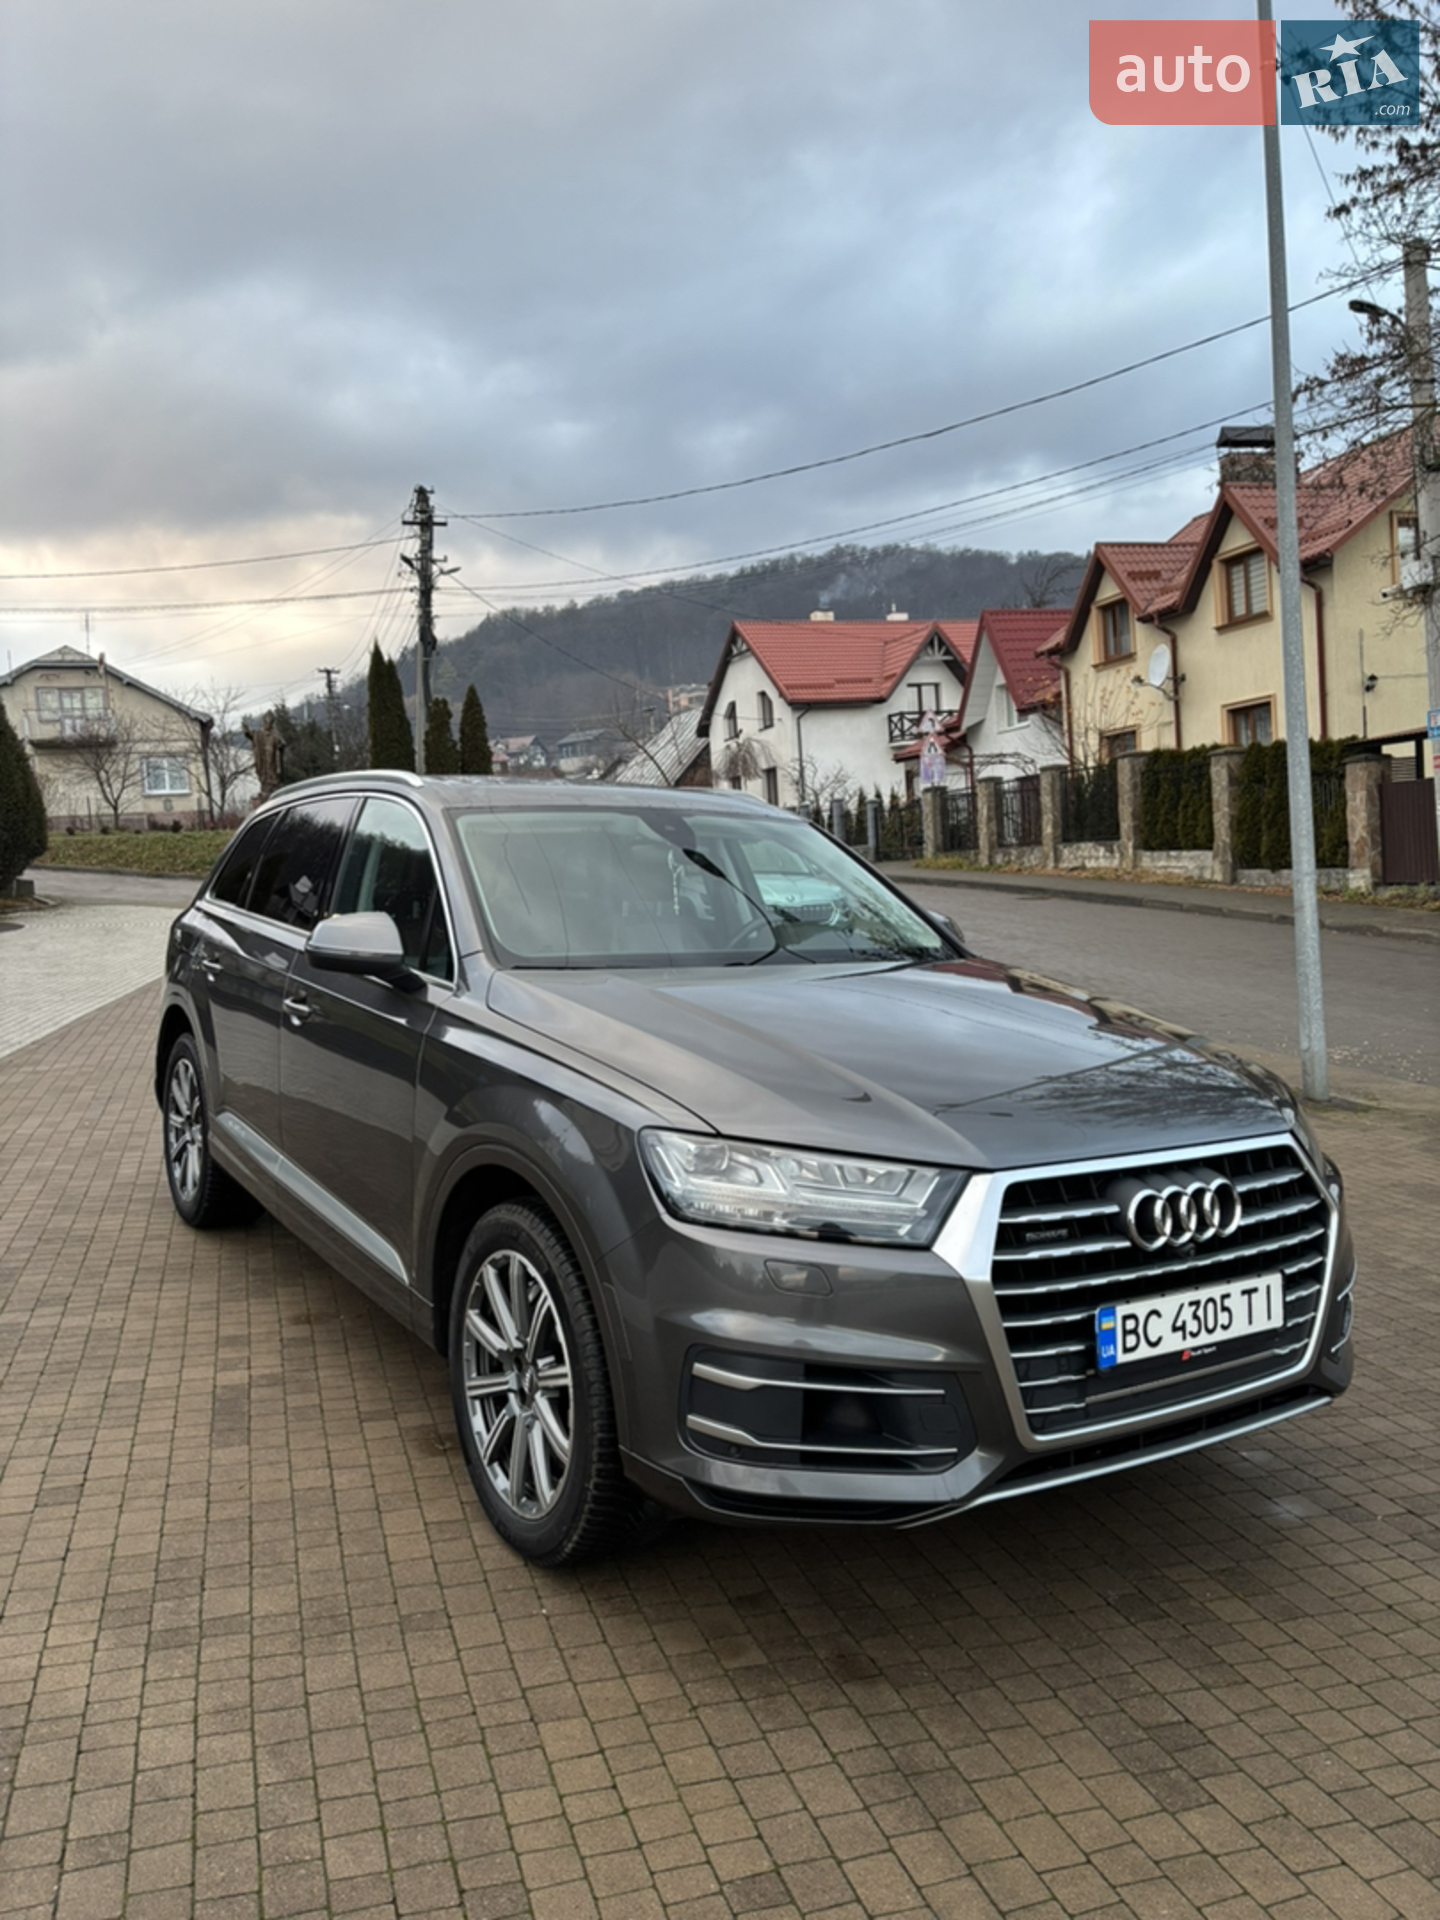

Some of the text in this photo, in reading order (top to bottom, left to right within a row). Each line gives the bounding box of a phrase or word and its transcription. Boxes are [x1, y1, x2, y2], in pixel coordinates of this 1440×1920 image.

[1121, 1284, 1272, 1354] BC 4305 TI
[1101, 1344, 1116, 1358] UA
